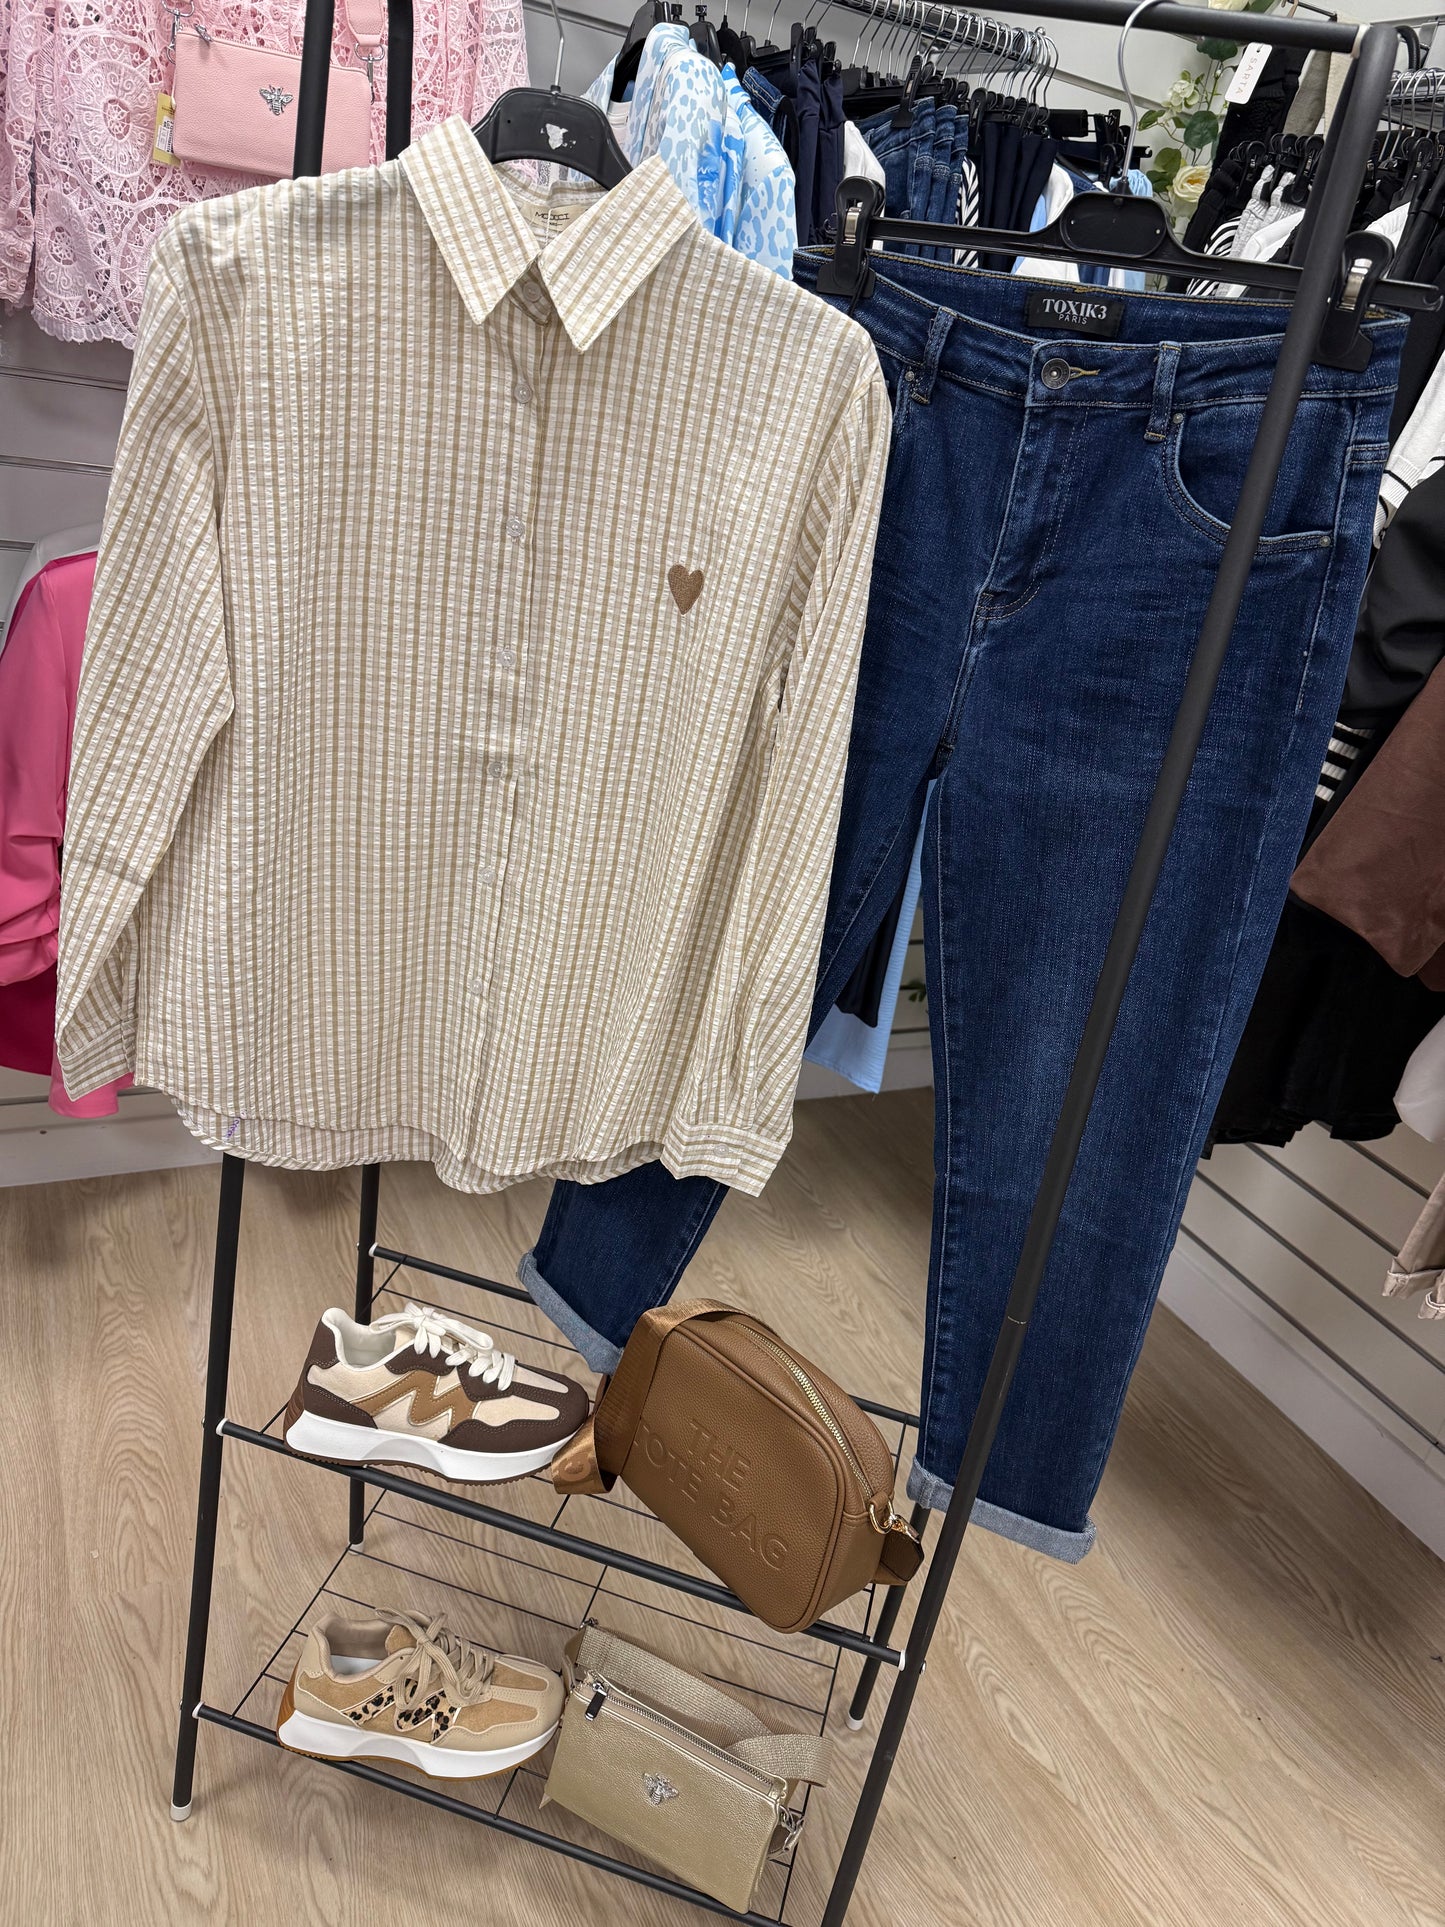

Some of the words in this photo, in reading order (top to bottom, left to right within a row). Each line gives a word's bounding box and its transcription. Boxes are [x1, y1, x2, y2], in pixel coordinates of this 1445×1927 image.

[1042, 298, 1107, 320] TOXIK3
[1058, 313, 1088, 325] PARIS
[685, 1418, 752, 1492] THE
[711, 1491, 788, 1571] BAG
